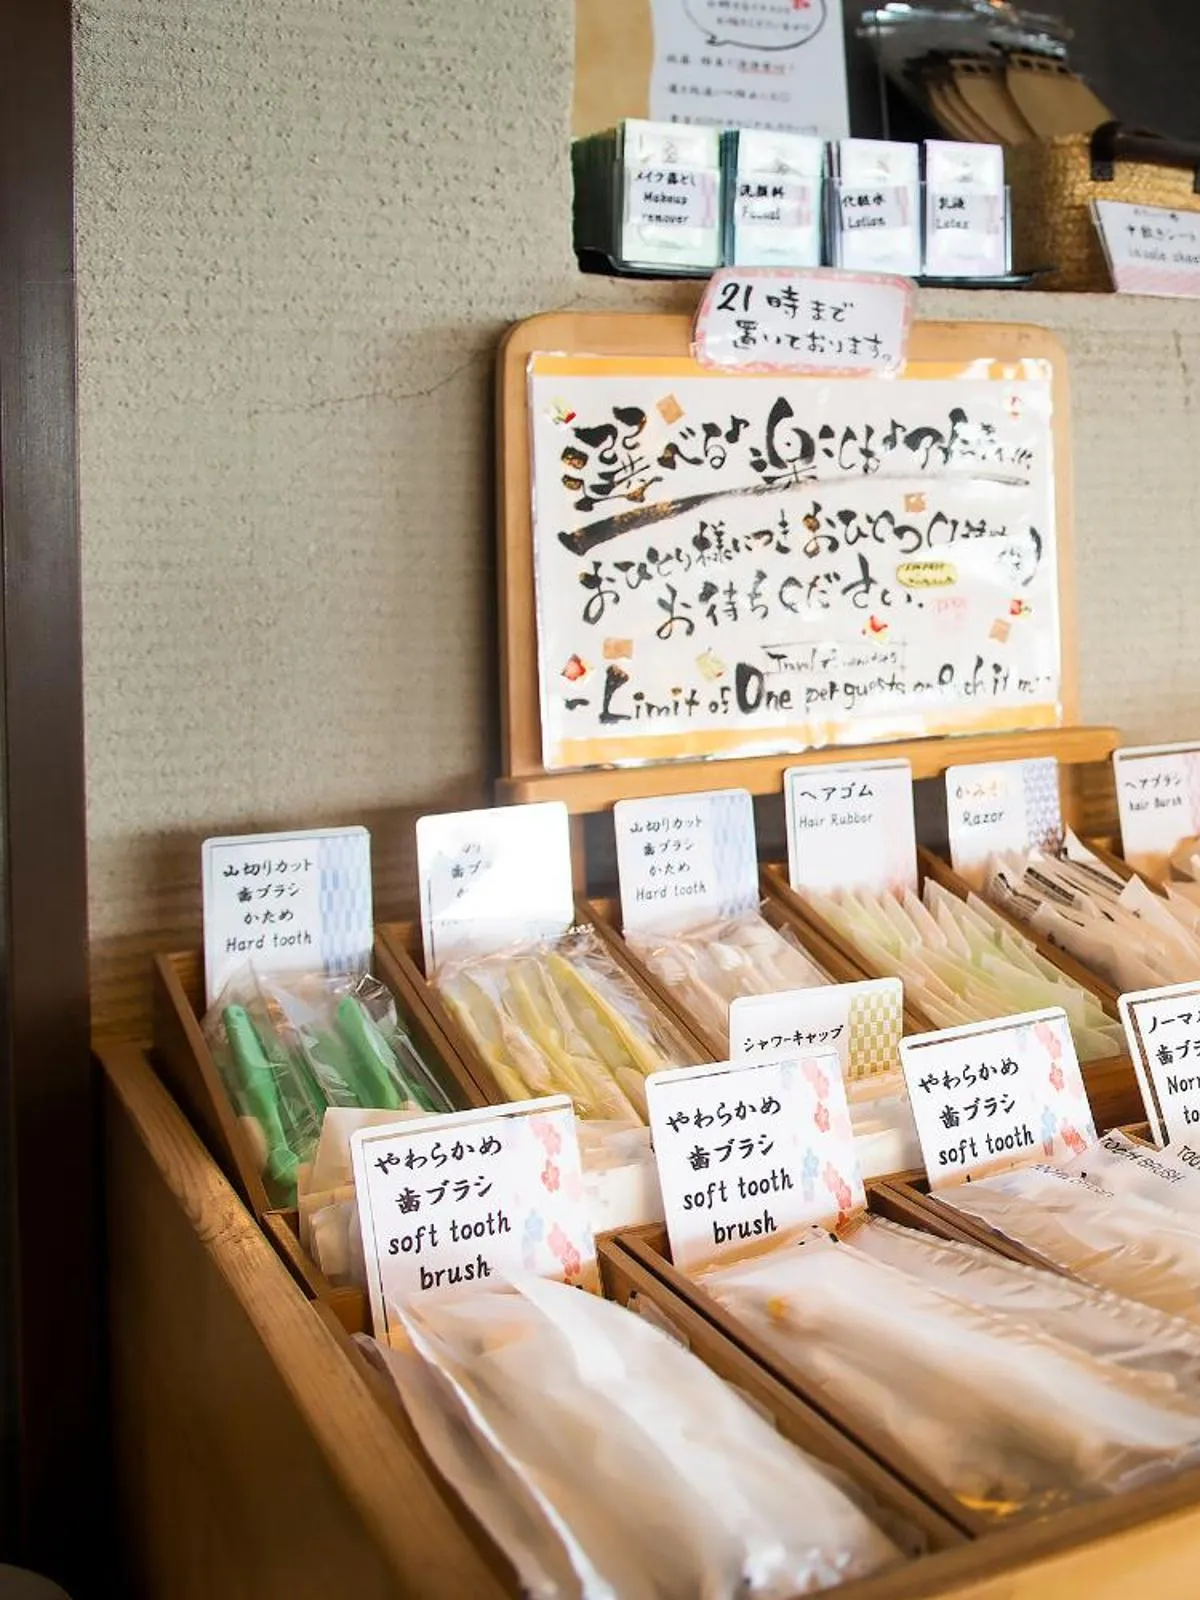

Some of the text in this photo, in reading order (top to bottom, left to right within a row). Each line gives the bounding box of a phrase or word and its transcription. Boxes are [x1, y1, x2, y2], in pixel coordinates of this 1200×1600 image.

[735, 661, 794, 715] One
[800, 782, 875, 801] ヘアゴム
[1125, 772, 1181, 789] ヘアブラシ
[629, 816, 703, 834] 山切りカット
[799, 815, 826, 829] Hair
[962, 811, 1004, 827] Razor
[643, 841, 695, 857] 歯ブラシ
[223, 859, 314, 878] 山切りカット
[648, 862, 691, 877] かため
[237, 884, 301, 903] 歯ブラシ
[636, 882, 707, 902] Hard tooth
[244, 909, 294, 926] かため
[226, 931, 312, 953] Hard tooth
[743, 1025, 844, 1053] シャワーキャップ
[918, 1057, 1020, 1094] やわらかめ
[666, 1096, 782, 1133] やわらかめ
[938, 1092, 1016, 1129] 歯ブラシ
[374, 1135, 503, 1176] やわらかめ
[686, 1133, 775, 1171] 歯ブラシ
[938, 1124, 1035, 1167] soft tooth
[395, 1175, 494, 1214] 歯ブラシ
[683, 1167, 795, 1211] soft tooth
[388, 1211, 511, 1258] soft tooth
[712, 1213, 778, 1244] brush
[419, 1254, 491, 1291] brush
